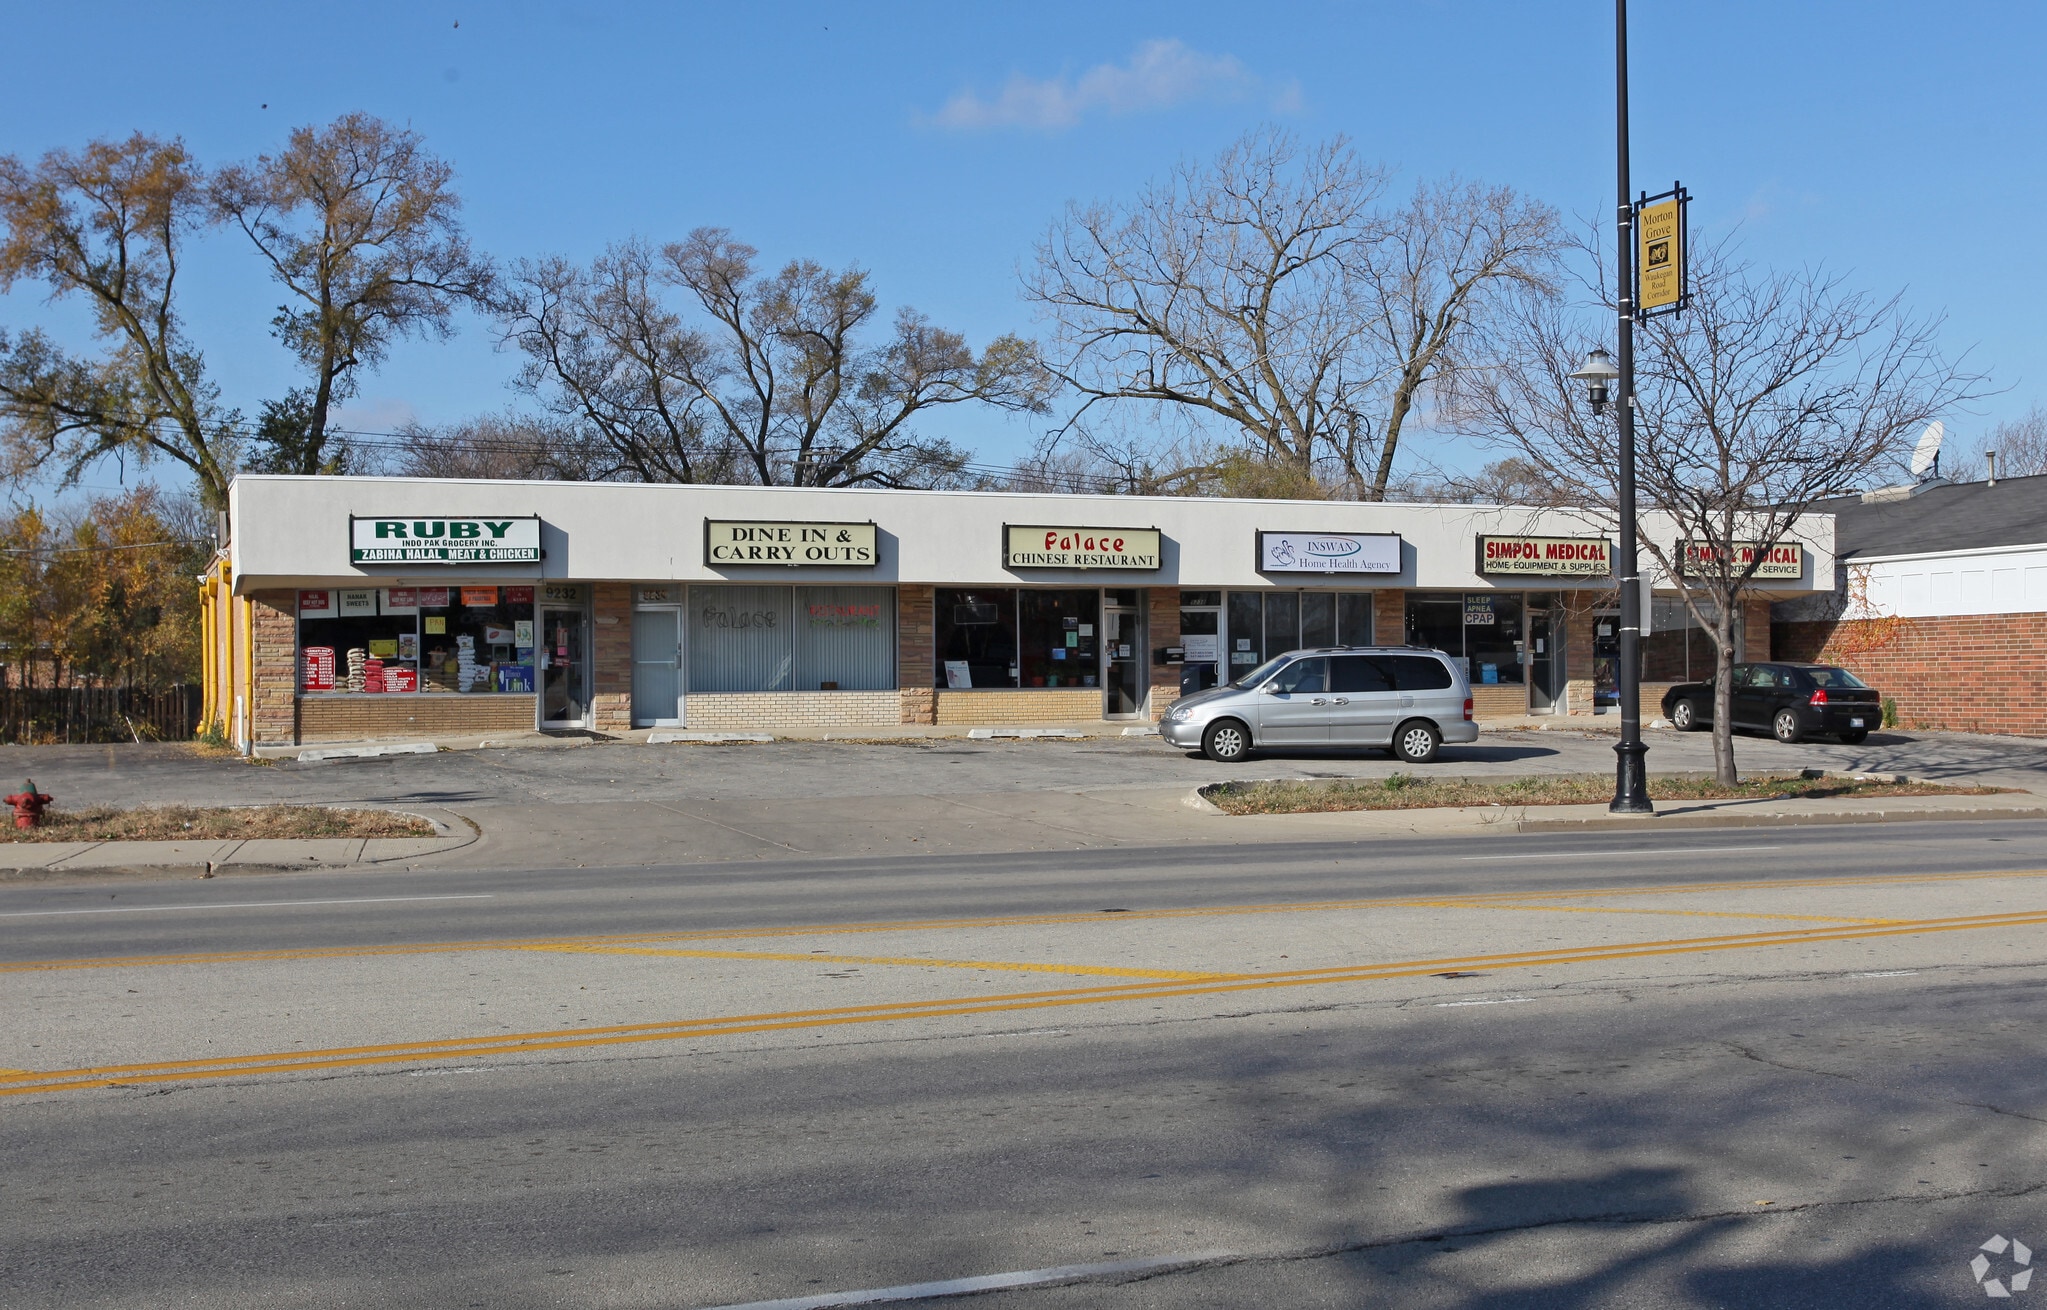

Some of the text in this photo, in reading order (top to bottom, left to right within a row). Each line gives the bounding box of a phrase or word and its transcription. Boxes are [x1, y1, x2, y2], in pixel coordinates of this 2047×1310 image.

[1643, 210, 1673, 227] Morton
[1645, 225, 1671, 239] Grove
[1645, 270, 1673, 281] Waukegan
[1651, 280, 1666, 290] Road
[375, 521, 514, 538] RUBY
[731, 527, 852, 543] DINE IN &
[402, 539, 422, 547] INDO
[424, 539, 440, 547] PAK
[1044, 531, 1125, 552] Palace
[1307, 541, 1353, 552] INSWAN
[362, 549, 535, 560] ZABIHA HALAL MEAT & CHICKEN
[713, 545, 870, 561] CARRY OUTS
[1486, 541, 1605, 561] SIMPOL MEDICAL
[1686, 546, 1797, 564] SML MDICAL
[1012, 552, 1155, 566] CHINESE RESTAURANT
[1299, 558, 1391, 571] Home Health Agency
[1486, 561, 1510, 569] HOME
[1513, 562, 1558, 570] EQUIPMENT
[1570, 563, 1606, 571] SUPPLIES
[1763, 566, 1796, 574] SERVICE
[545, 587, 576, 600] 9232
[1465, 613, 1494, 624] CPAP
[505, 678, 531, 692] Link
